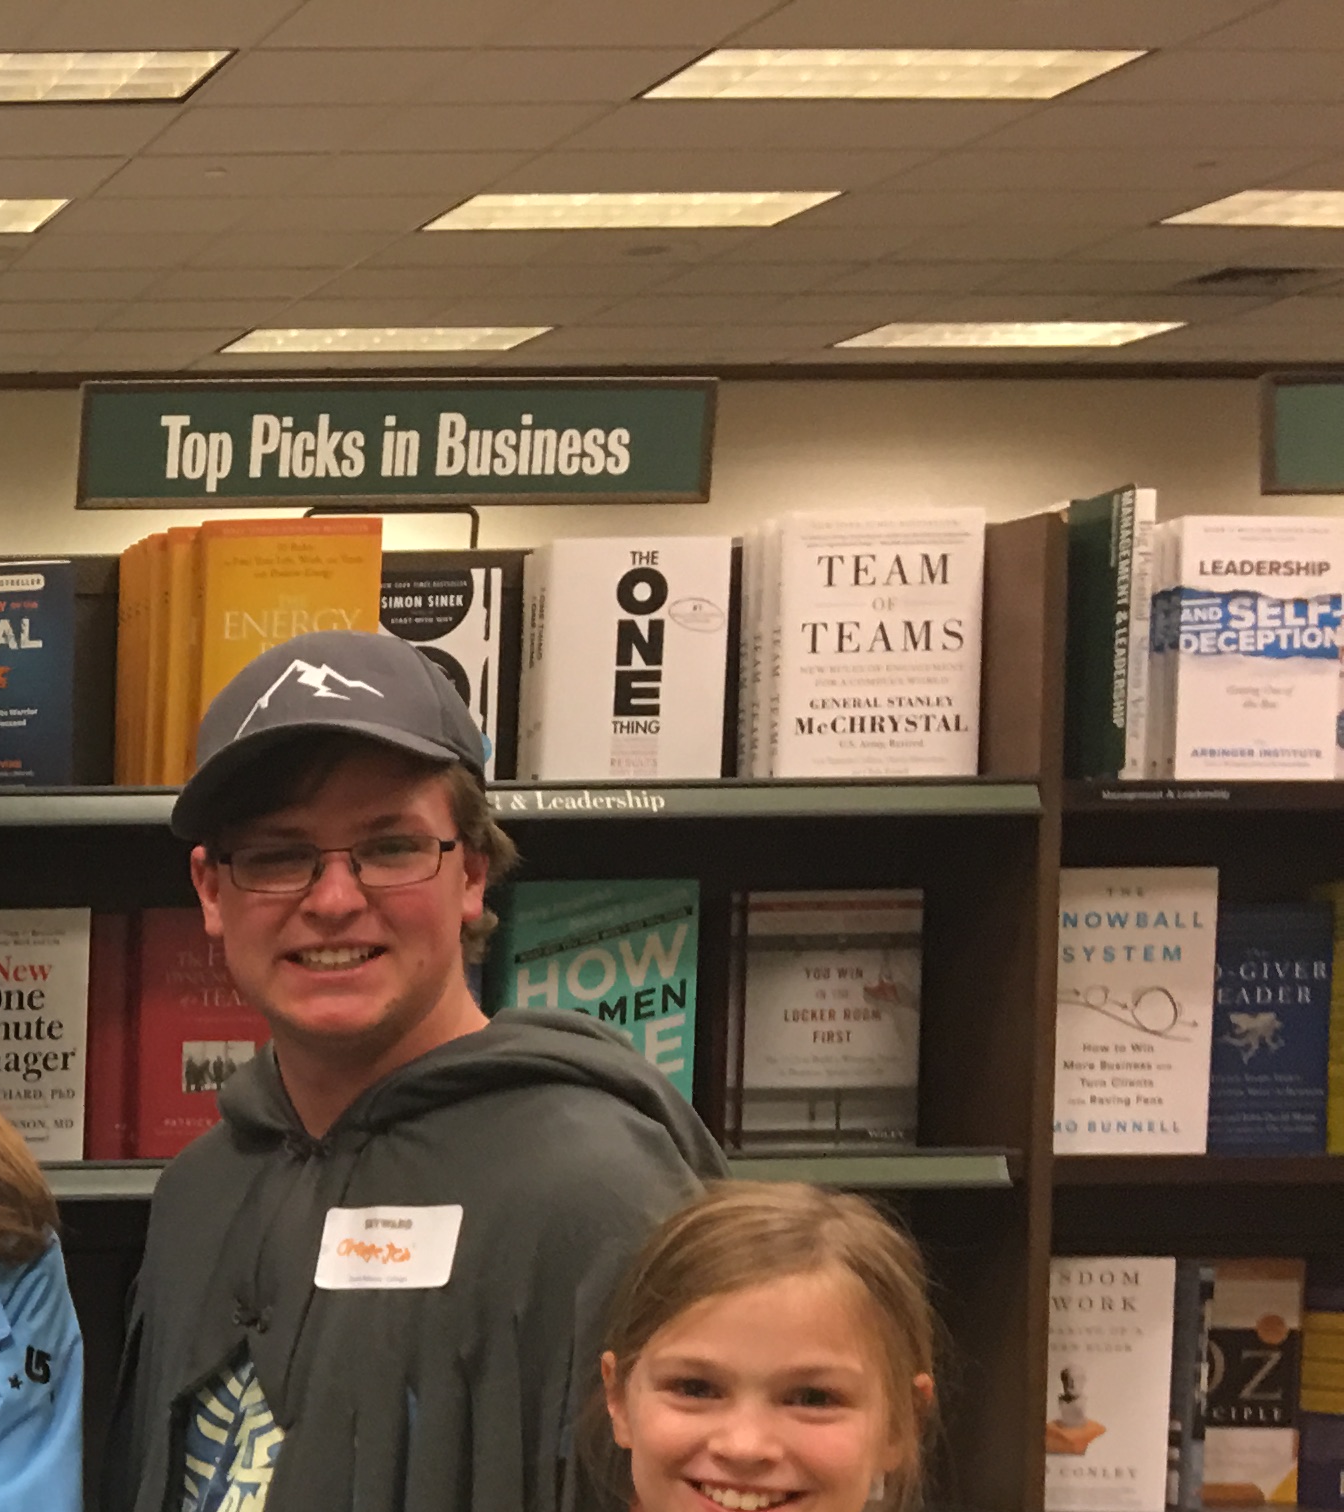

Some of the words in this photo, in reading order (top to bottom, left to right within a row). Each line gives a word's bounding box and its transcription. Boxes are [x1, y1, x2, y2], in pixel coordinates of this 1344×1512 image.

[160, 414, 233, 492] Top
[248, 413, 365, 480] Picks
[381, 414, 419, 478] in
[435, 412, 631, 477] Business
[1116, 489, 1134, 606] MANAGEMENT
[630, 550, 659, 565] THE
[816, 552, 953, 588] TEAM
[1198, 559, 1332, 578] LEADERSHIP
[380, 596, 423, 609] SIMON
[427, 595, 464, 608] SINEK
[871, 597, 897, 612] OF
[1115, 611, 1127, 625] &
[1181, 607, 1224, 624] AND
[1226, 597, 1344, 630] SELF-
[223, 608, 362, 641] ENERGY
[613, 567, 669, 717] ONE
[800, 618, 965, 655] TEAMS
[1179, 627, 1344, 654] DECEPTION
[1113, 629, 1130, 729] LEADERSHIP
[808, 696, 881, 711] GENERAL
[887, 695, 955, 710] STANLEY
[611, 720, 660, 735] THING
[794, 712, 970, 736] McCHRYSTAL
[510, 792, 527, 810] &
[536, 790, 666, 812] Leadership
[1105, 886, 1147, 899] THE
[1062, 911, 1205, 930] NOWBALL
[1062, 945, 1183, 963] SYSTEM
[516, 924, 689, 1009] HOW
[804, 967, 832, 981] YOU
[837, 967, 864, 980] WIN
[574, 978, 687, 1026] MEN
[783, 1009, 838, 1023] LOCKER
[844, 1009, 882, 1022] ROOM
[812, 1030, 853, 1044] FIRST
[1082, 1043, 1110, 1054] How
[1099, 1060, 1153, 1071] Business
[1111, 1076, 1154, 1088] Clients
[49, 1088, 77, 1101] PhD
[53, 1119, 75, 1130] MD
[1087, 1119, 1181, 1134] BUNNELL
[1051, 1296, 1138, 1313] WORK
